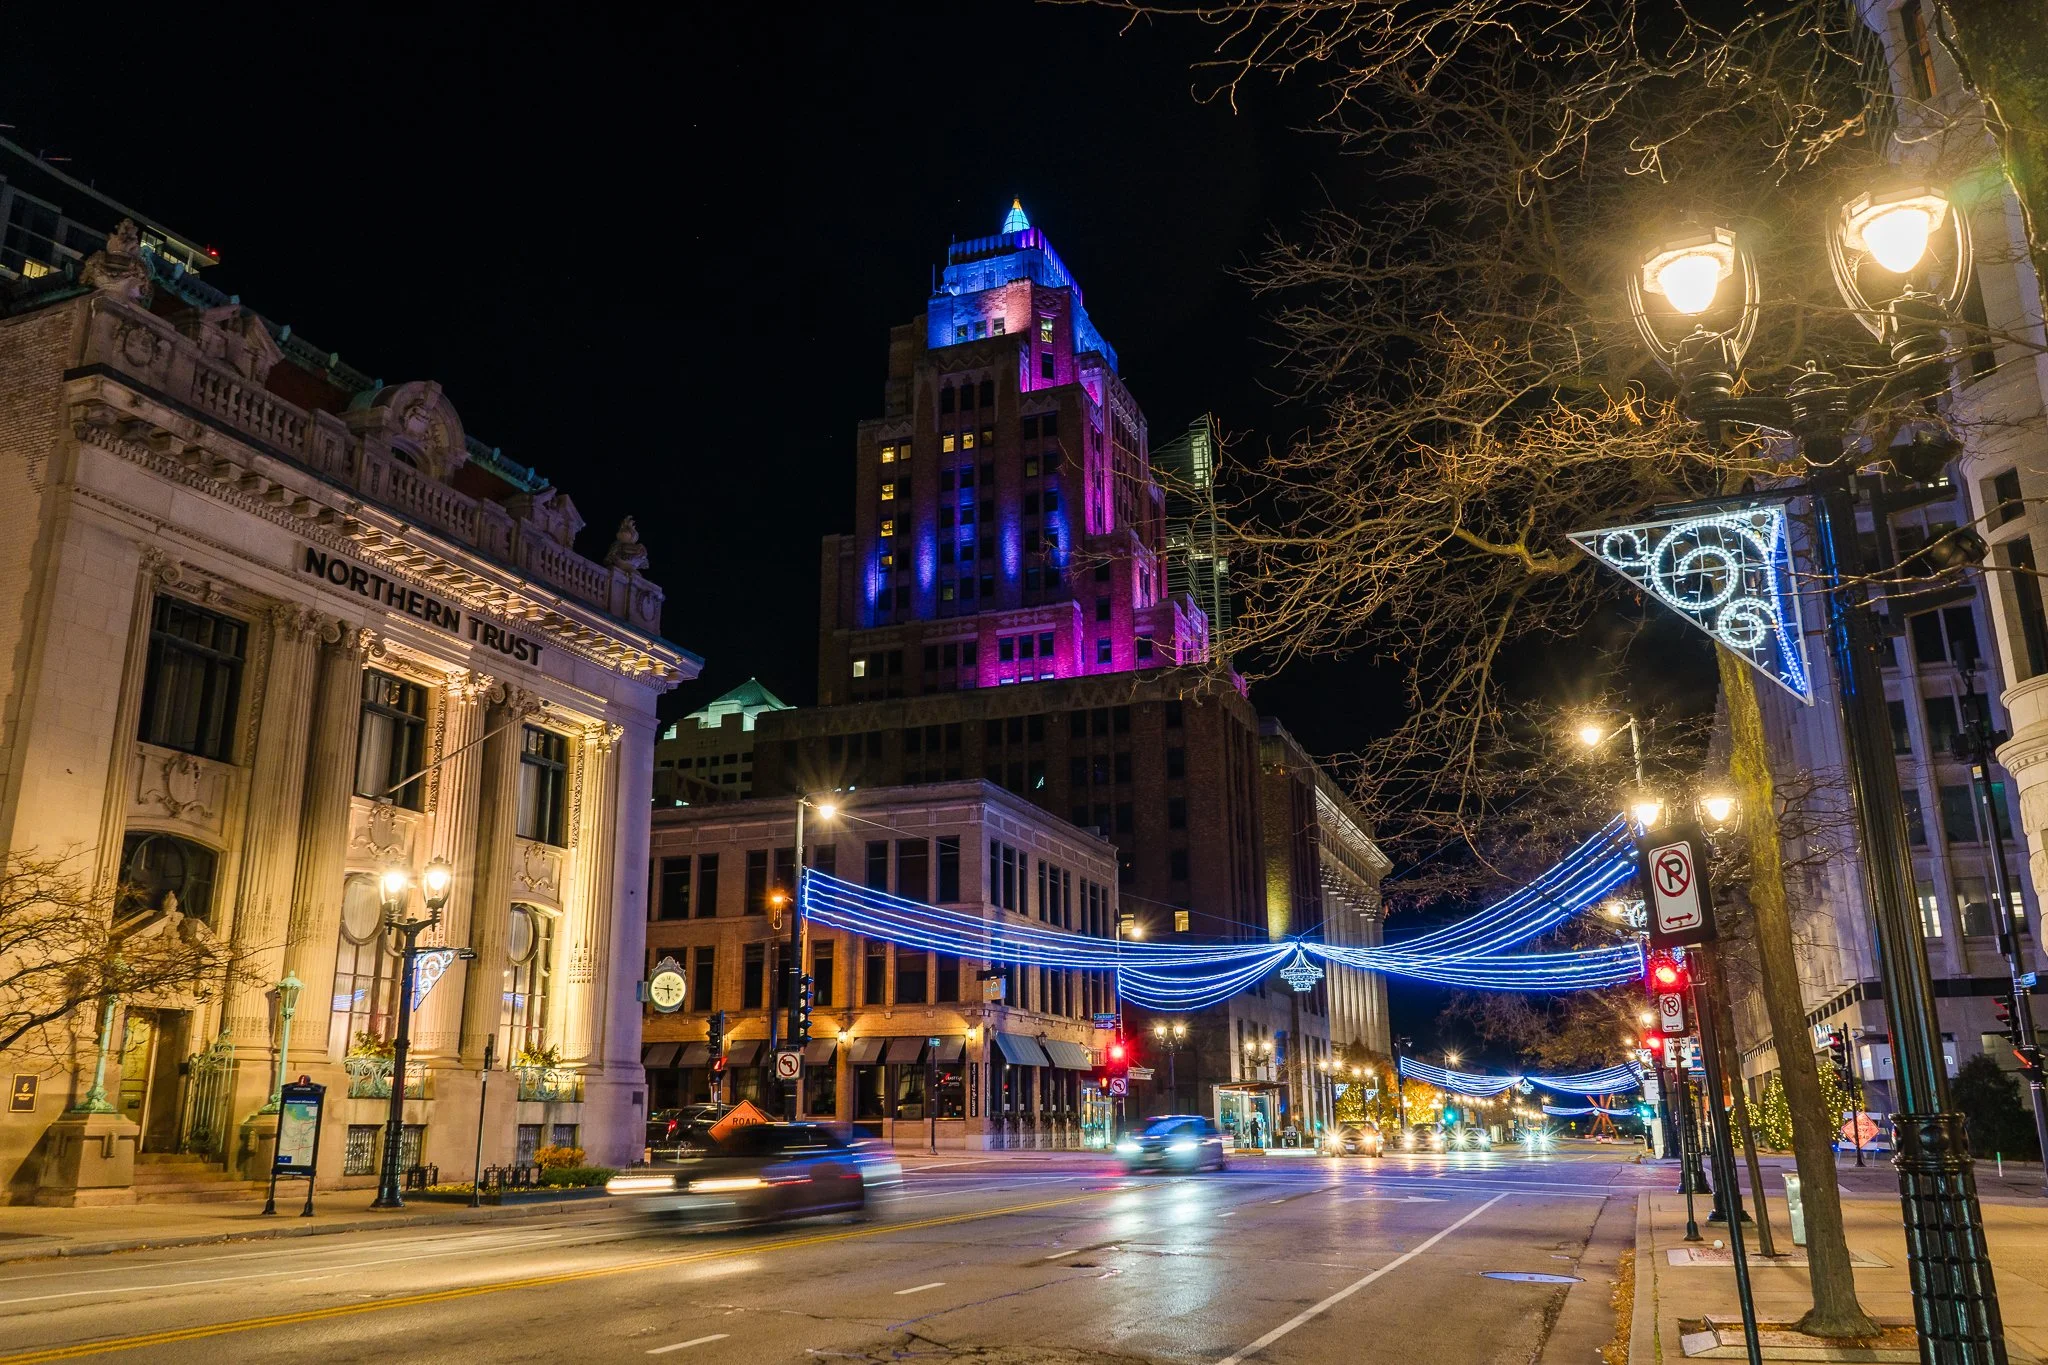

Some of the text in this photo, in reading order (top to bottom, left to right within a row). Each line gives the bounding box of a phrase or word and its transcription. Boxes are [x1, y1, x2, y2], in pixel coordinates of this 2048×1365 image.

[305, 547, 543, 666] NORTHERN TRUST
[732, 1117, 758, 1126] ROAD
